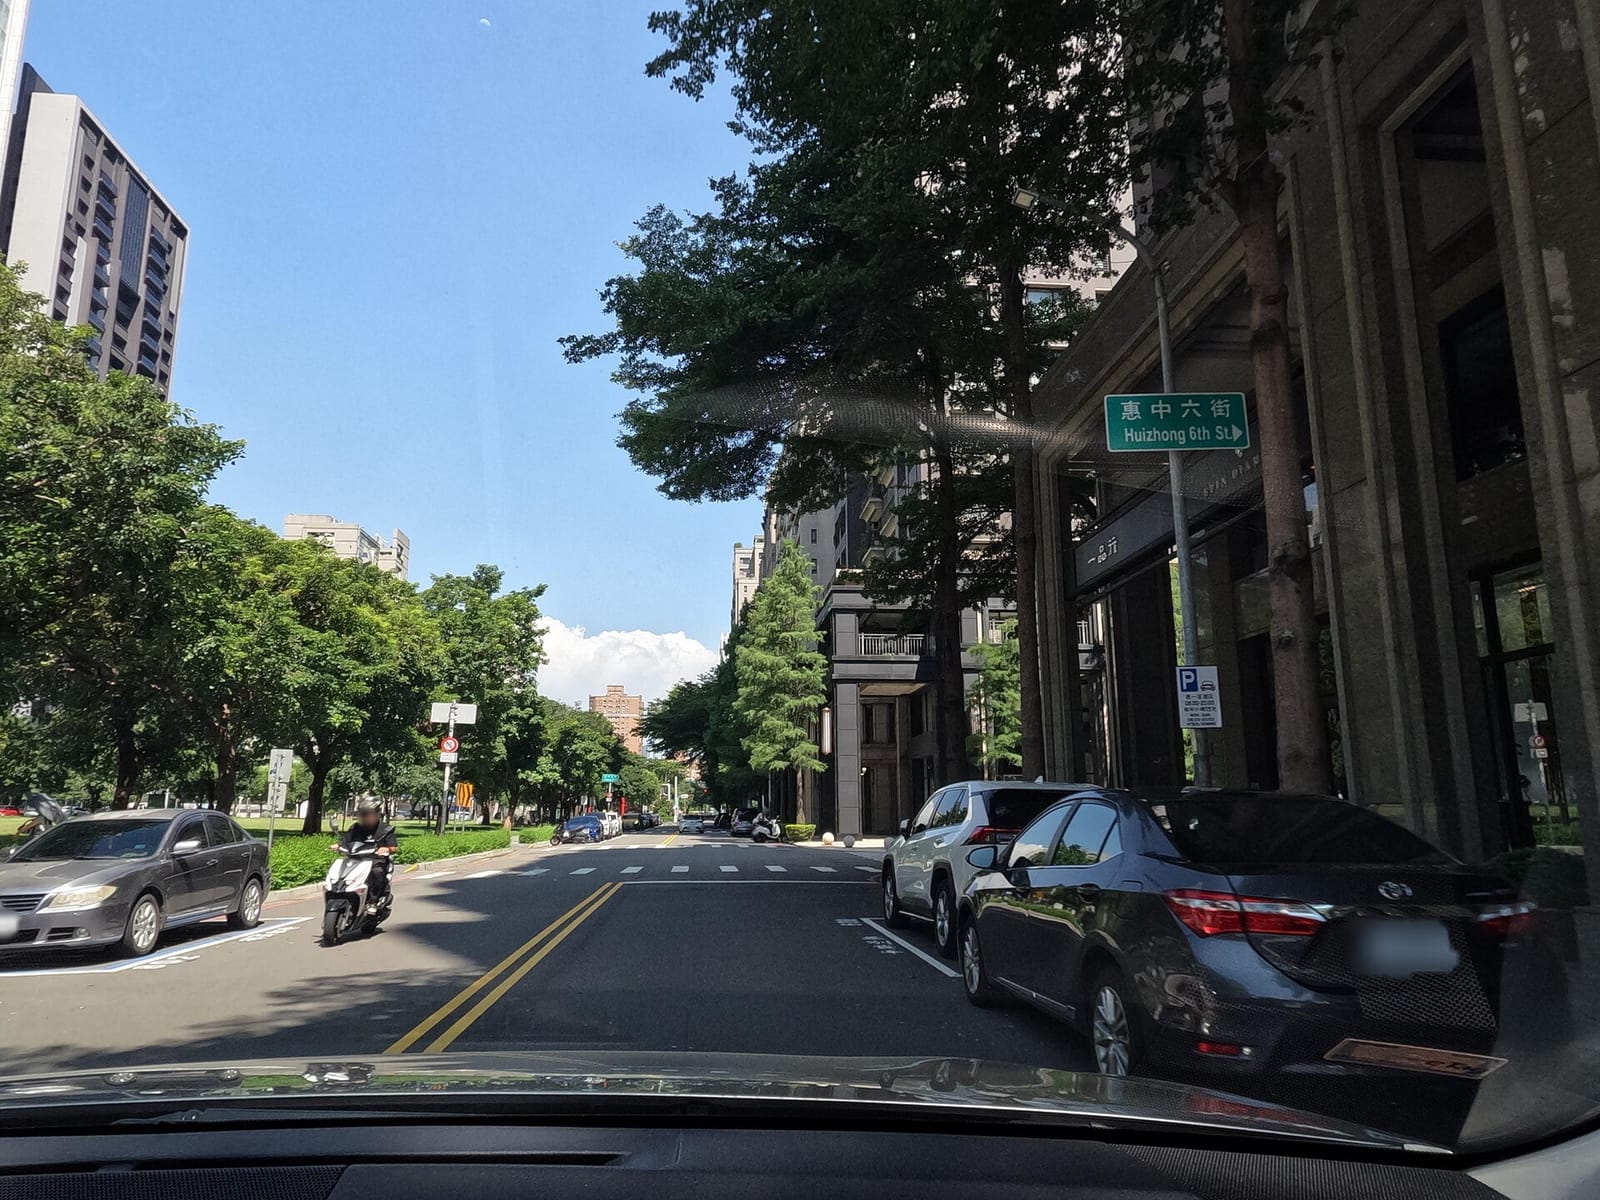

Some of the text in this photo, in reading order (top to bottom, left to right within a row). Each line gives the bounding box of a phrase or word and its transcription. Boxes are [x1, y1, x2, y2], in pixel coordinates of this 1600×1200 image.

[1120, 399, 1231, 421] 惠中六街
[1124, 427, 1186, 445] Huizhong
[1189, 425, 1210, 441] 6th
